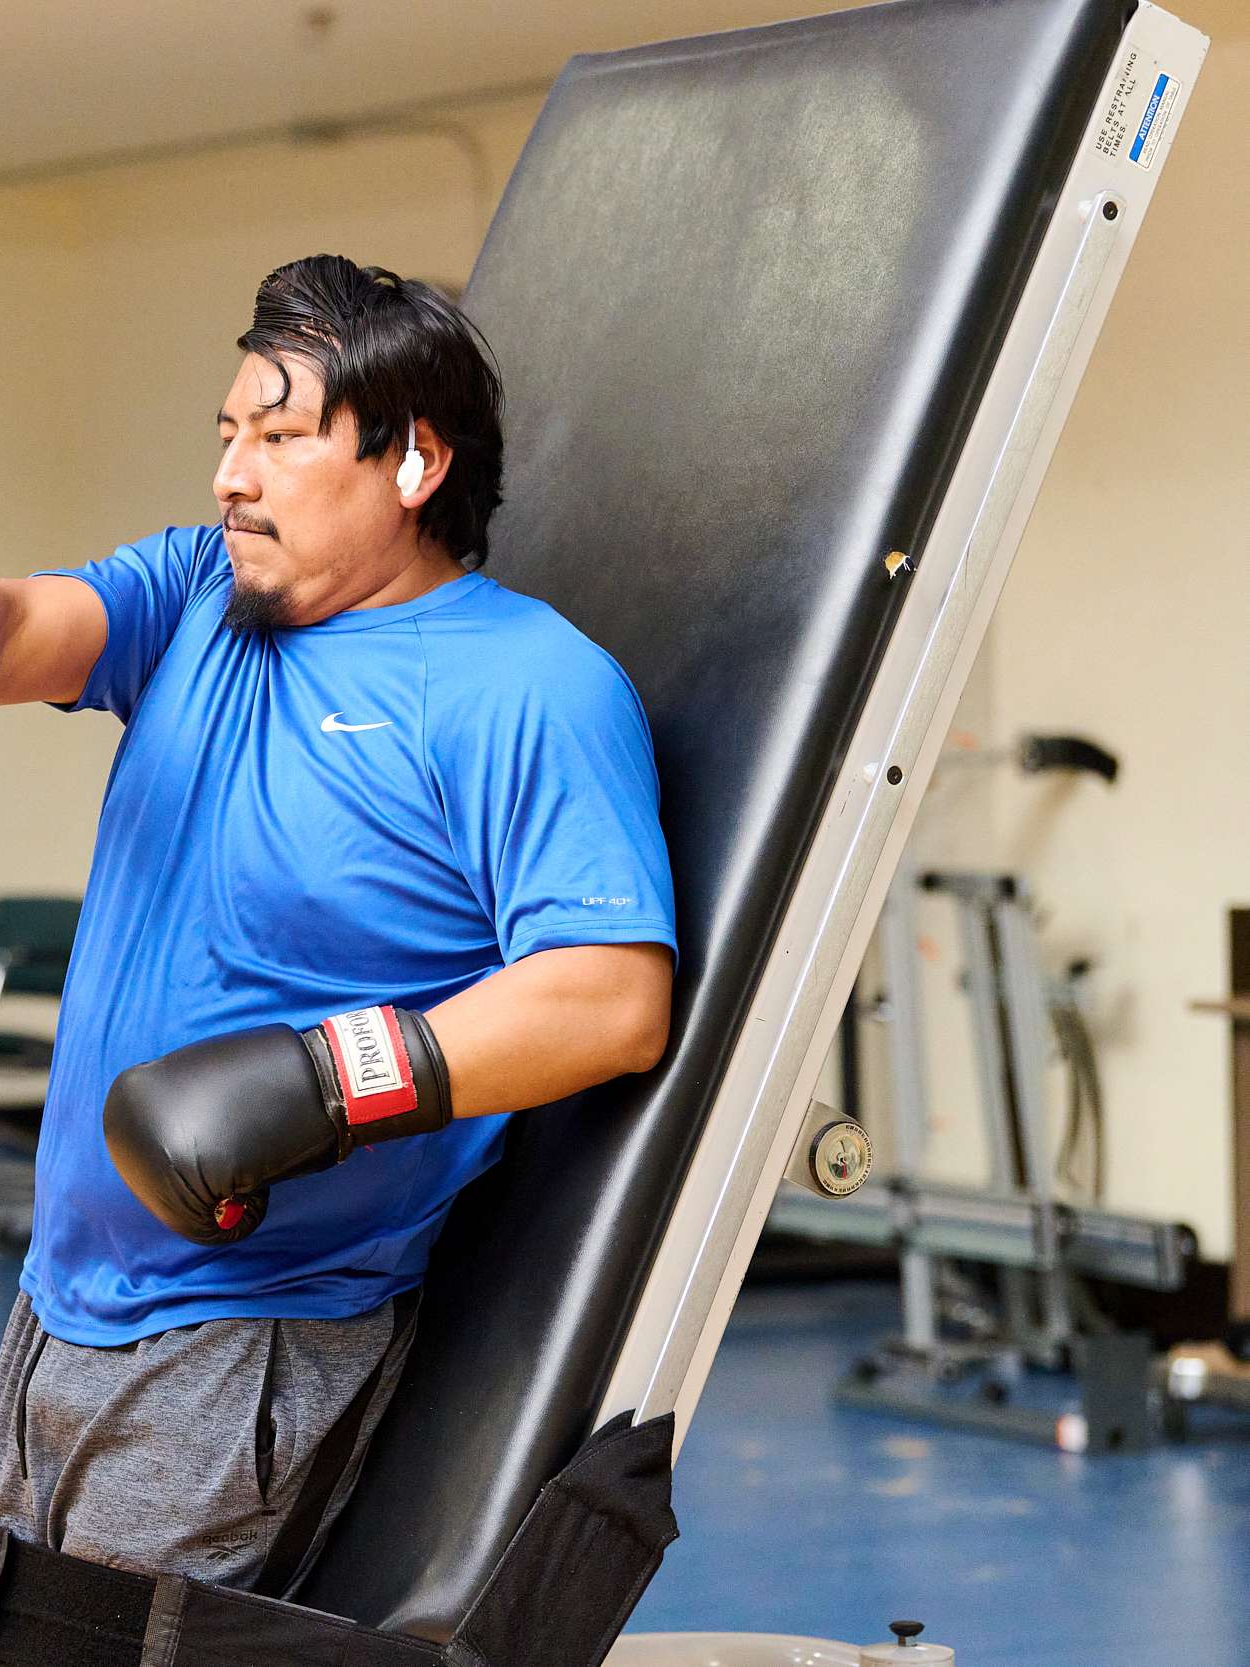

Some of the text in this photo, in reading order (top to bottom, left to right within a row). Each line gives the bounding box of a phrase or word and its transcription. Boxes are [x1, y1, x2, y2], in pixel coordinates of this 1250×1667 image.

[1102, 79, 1136, 154] BELTS AT ALL
[1138, 94, 1161, 141] ATTENTION
[1096, 129, 1108, 150] USE
[582, 897, 607, 906] UPF
[203, 1529, 258, 1545] Reebok
